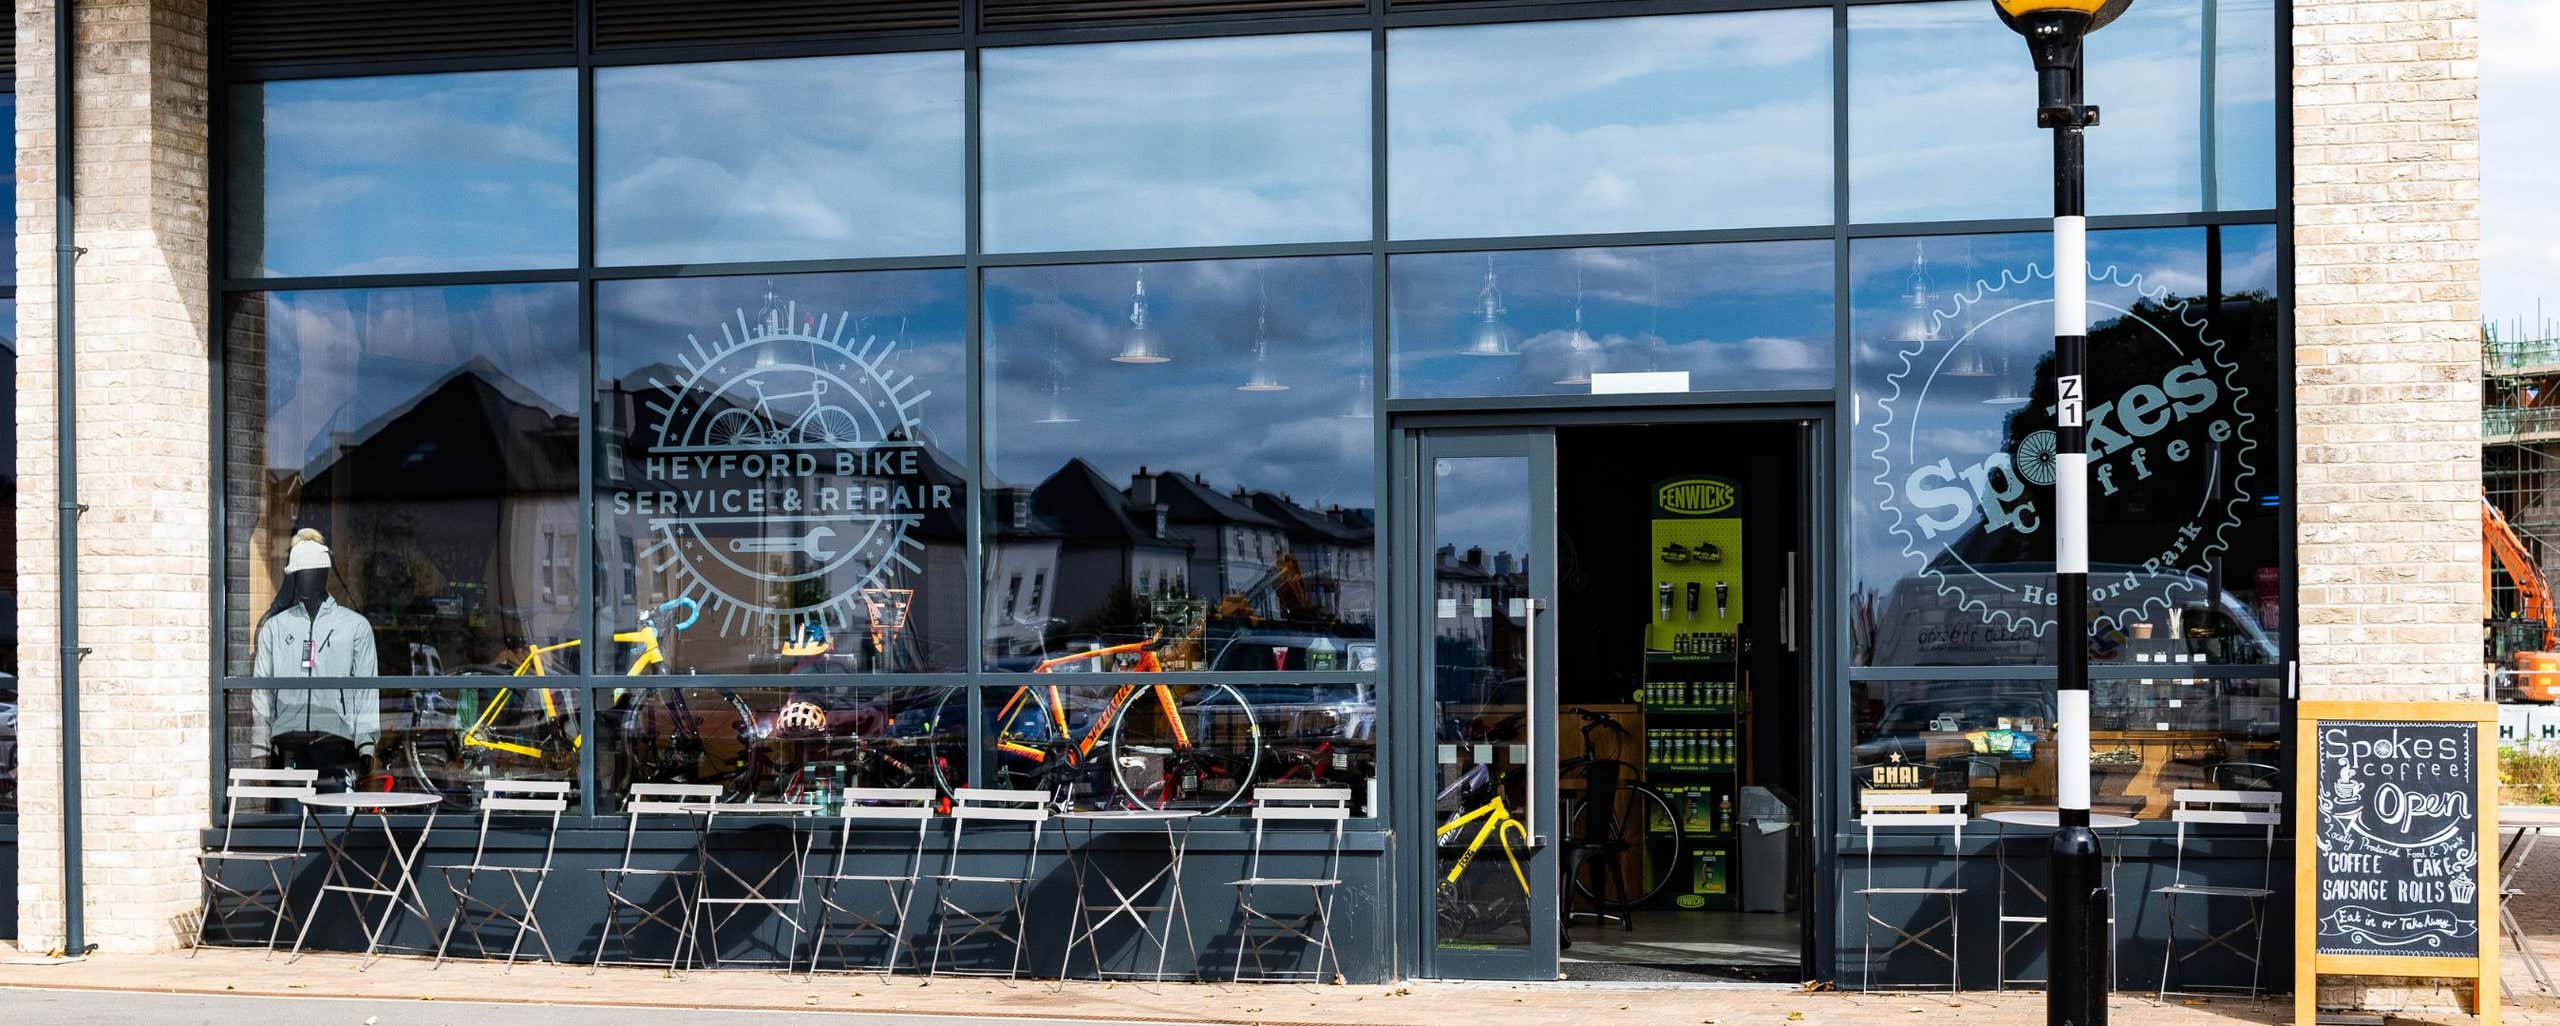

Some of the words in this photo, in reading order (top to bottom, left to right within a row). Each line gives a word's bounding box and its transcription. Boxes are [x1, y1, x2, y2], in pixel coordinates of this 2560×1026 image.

[646, 453, 817, 480] HEYFORD
[835, 451, 918, 477] BIKE
[2009, 419, 2232, 534] cffee
[614, 488, 765, 515] SERVICE
[782, 487, 802, 511] &
[821, 485, 952, 511] REPAIR
[2022, 571, 2141, 606] Heord
[2143, 521, 2202, 579] Park
[2325, 728, 2457, 768] Spokes
[1873, 766, 1919, 784] CHAI
[2363, 763, 2459, 781] coffee
[2374, 782, 2472, 833] Open
[2325, 823, 2354, 851] Locally
[2360, 837, 2400, 858] Produced
[2406, 848, 2428, 859] Food
[2429, 846, 2439, 858] &
[2440, 836, 2466, 855] Drink
[2328, 852, 2382, 874] COFFEE
[2322, 879, 2388, 900] SAUSAGE
[2398, 880, 2445, 903] ROLLS
[2338, 909, 2361, 923] Eat
[2365, 914, 2376, 928] in
[2382, 918, 2397, 929] or
